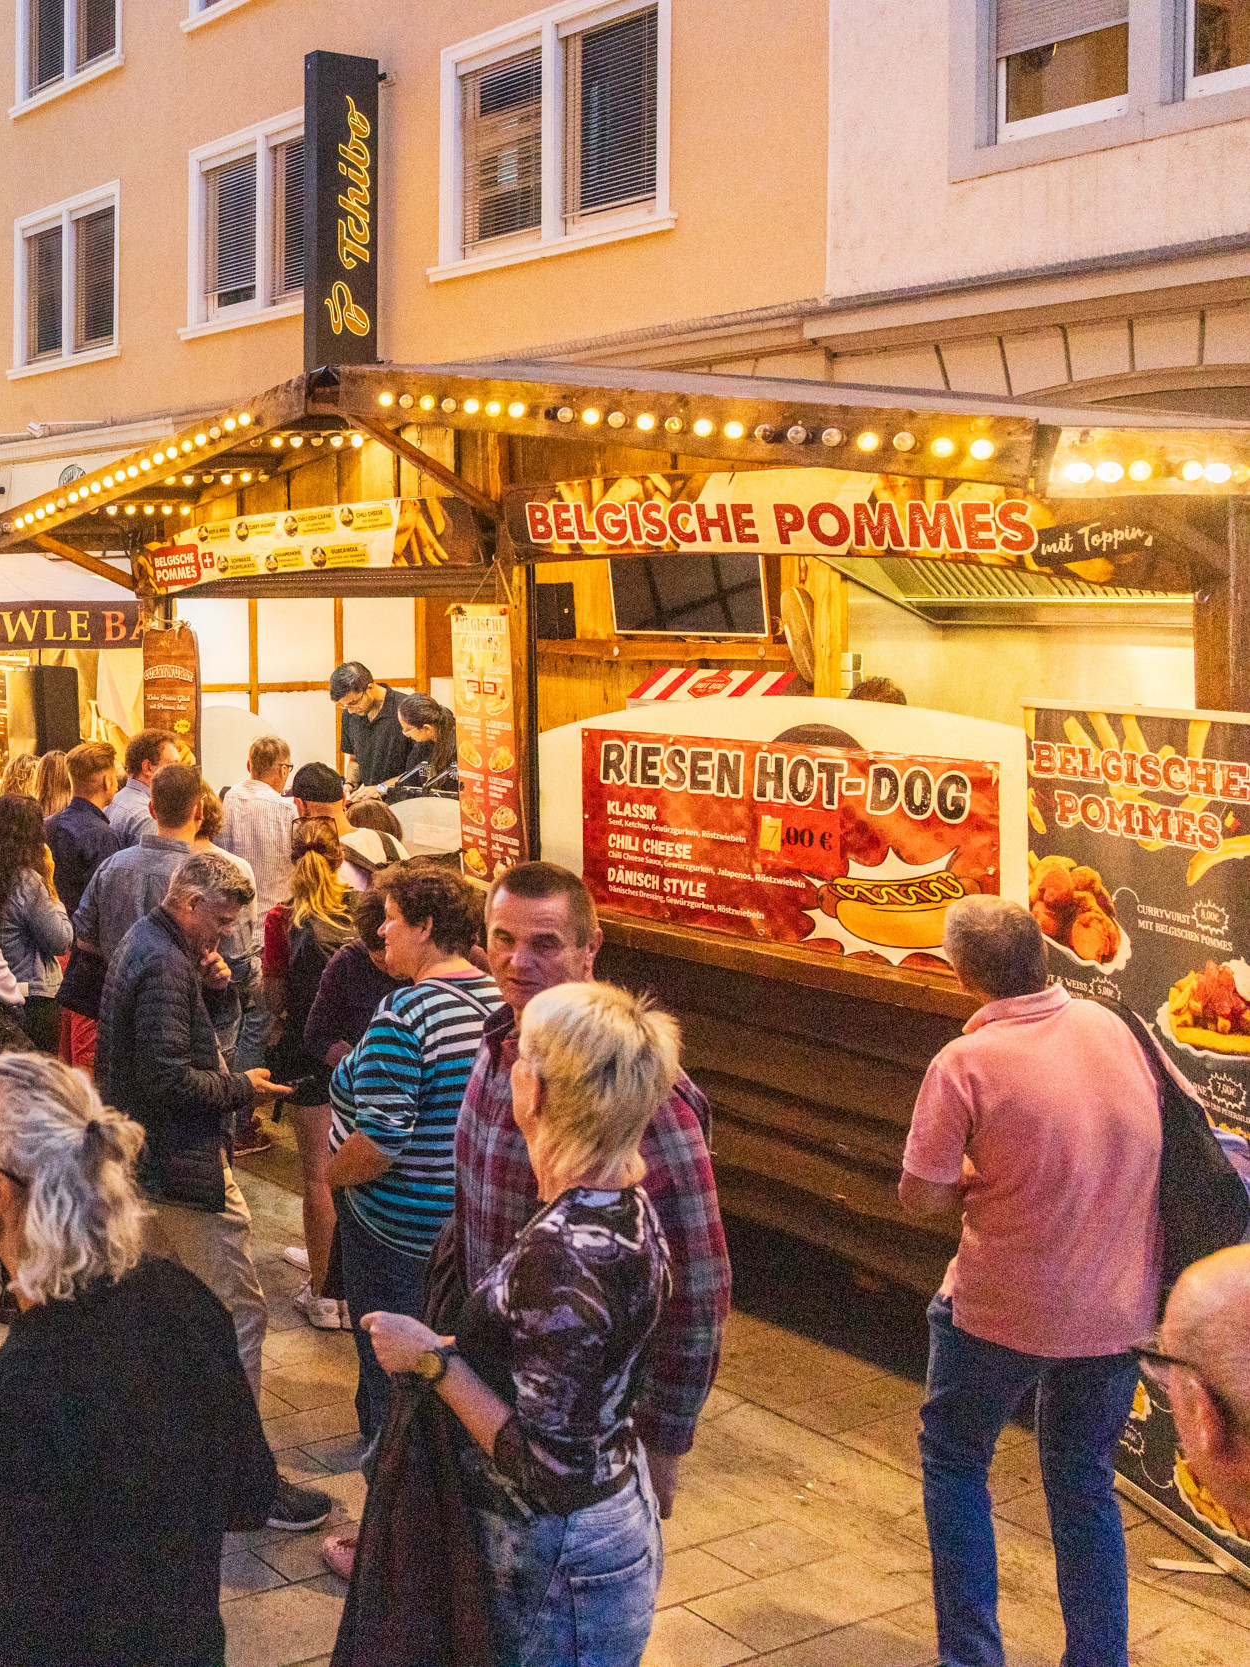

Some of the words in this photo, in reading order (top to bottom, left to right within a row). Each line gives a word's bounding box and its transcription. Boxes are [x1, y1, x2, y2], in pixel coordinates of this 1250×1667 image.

[337, 95, 371, 269] Tchibo
[525, 501, 760, 545] BELGISCHE
[772, 499, 1039, 555] POMMES
[1041, 533, 1073, 555] mit
[154, 552, 196, 568] BELGISCHE
[156, 565, 197, 582] POMMES
[144, 664, 193, 682] CURRYWURST
[600, 740, 745, 799] RIESEN
[753, 752, 971, 823] HOT-DOG
[1032, 741, 1250, 804] BELGISCHE
[607, 800, 657, 820] KLASSIK
[1054, 790, 1223, 853] POMMES
[608, 818, 624, 827] Senf,
[624, 820, 651, 831] Ketchup,
[651, 824, 701, 838] Gewürzgurken,
[702, 830, 747, 843] Röstzwiebeln
[608, 833, 639, 851] CHILI
[643, 839, 693, 859] CHEESE
[820, 832, 832, 851] €
[607, 865, 660, 890] DÄNISCH
[663, 880, 707, 898] STYLE
[608, 851, 623, 859] Chili
[623, 853, 645, 862] Cheese
[646, 856, 664, 868] Sauce,
[664, 860, 716, 876] Gewürzgurken,
[717, 868, 754, 882] Jalapenos,
[755, 873, 806, 888] Röstzwiebeln
[608, 885, 639, 897] Dänisches
[665, 896, 717, 914] Gewürzgurken,
[717, 904, 765, 920] Röstzwiebeln
[1137, 904, 1190, 925] CURRYWURST
[1138, 919, 1154, 930] MIT
[1155, 922, 1200, 942] BELGISCHEN
[1201, 935, 1233, 951] POMMES
